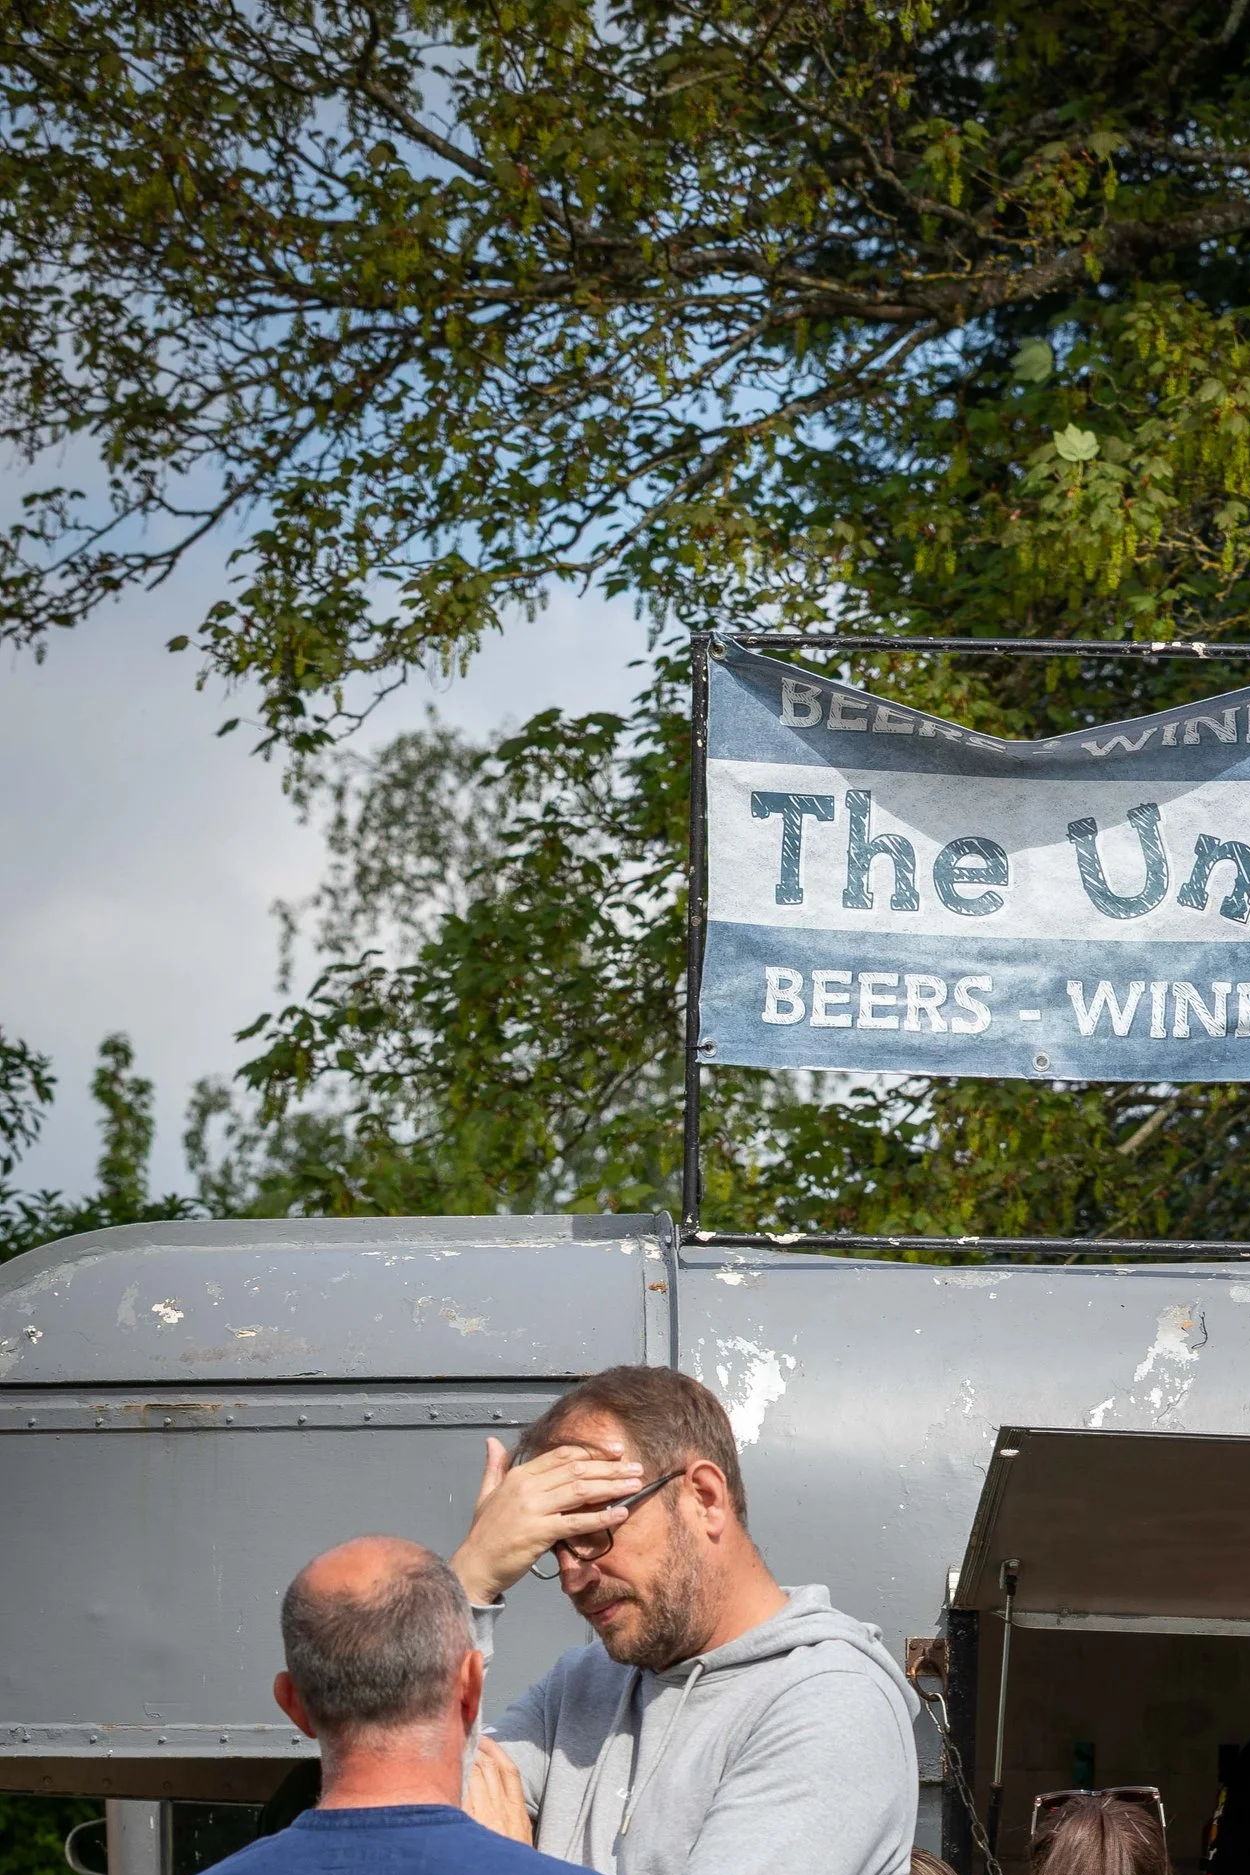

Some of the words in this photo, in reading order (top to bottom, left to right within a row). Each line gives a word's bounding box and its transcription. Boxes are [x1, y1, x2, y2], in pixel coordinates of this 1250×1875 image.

[779, 677, 1006, 753] BEERS
[750, 789, 1009, 916] The
[761, 966, 993, 1034] BEERS
